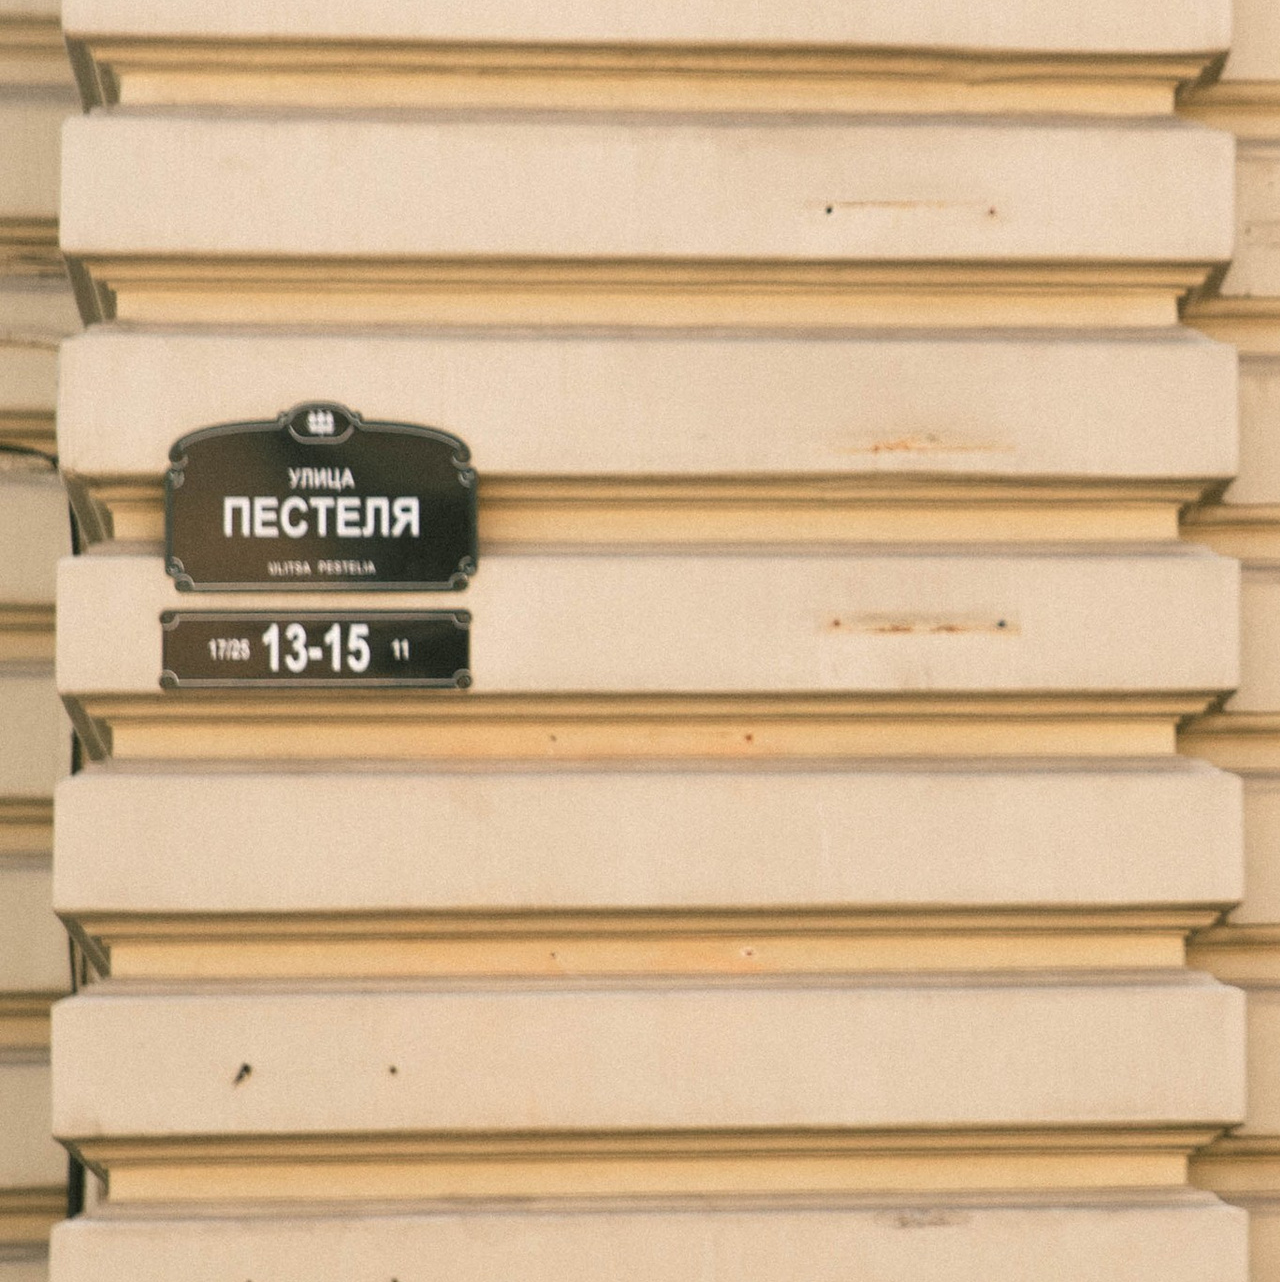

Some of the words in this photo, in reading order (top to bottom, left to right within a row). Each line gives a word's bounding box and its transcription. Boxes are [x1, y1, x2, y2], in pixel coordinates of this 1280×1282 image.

[287, 466, 355, 491] УЛИЦА
[223, 496, 420, 539] ПЕСТЕЛЯ
[267, 560, 311, 576] ULITSA
[317, 560, 377, 576] PESTELIA
[261, 622, 371, 673] 13-15
[390, 638, 410, 661] 11
